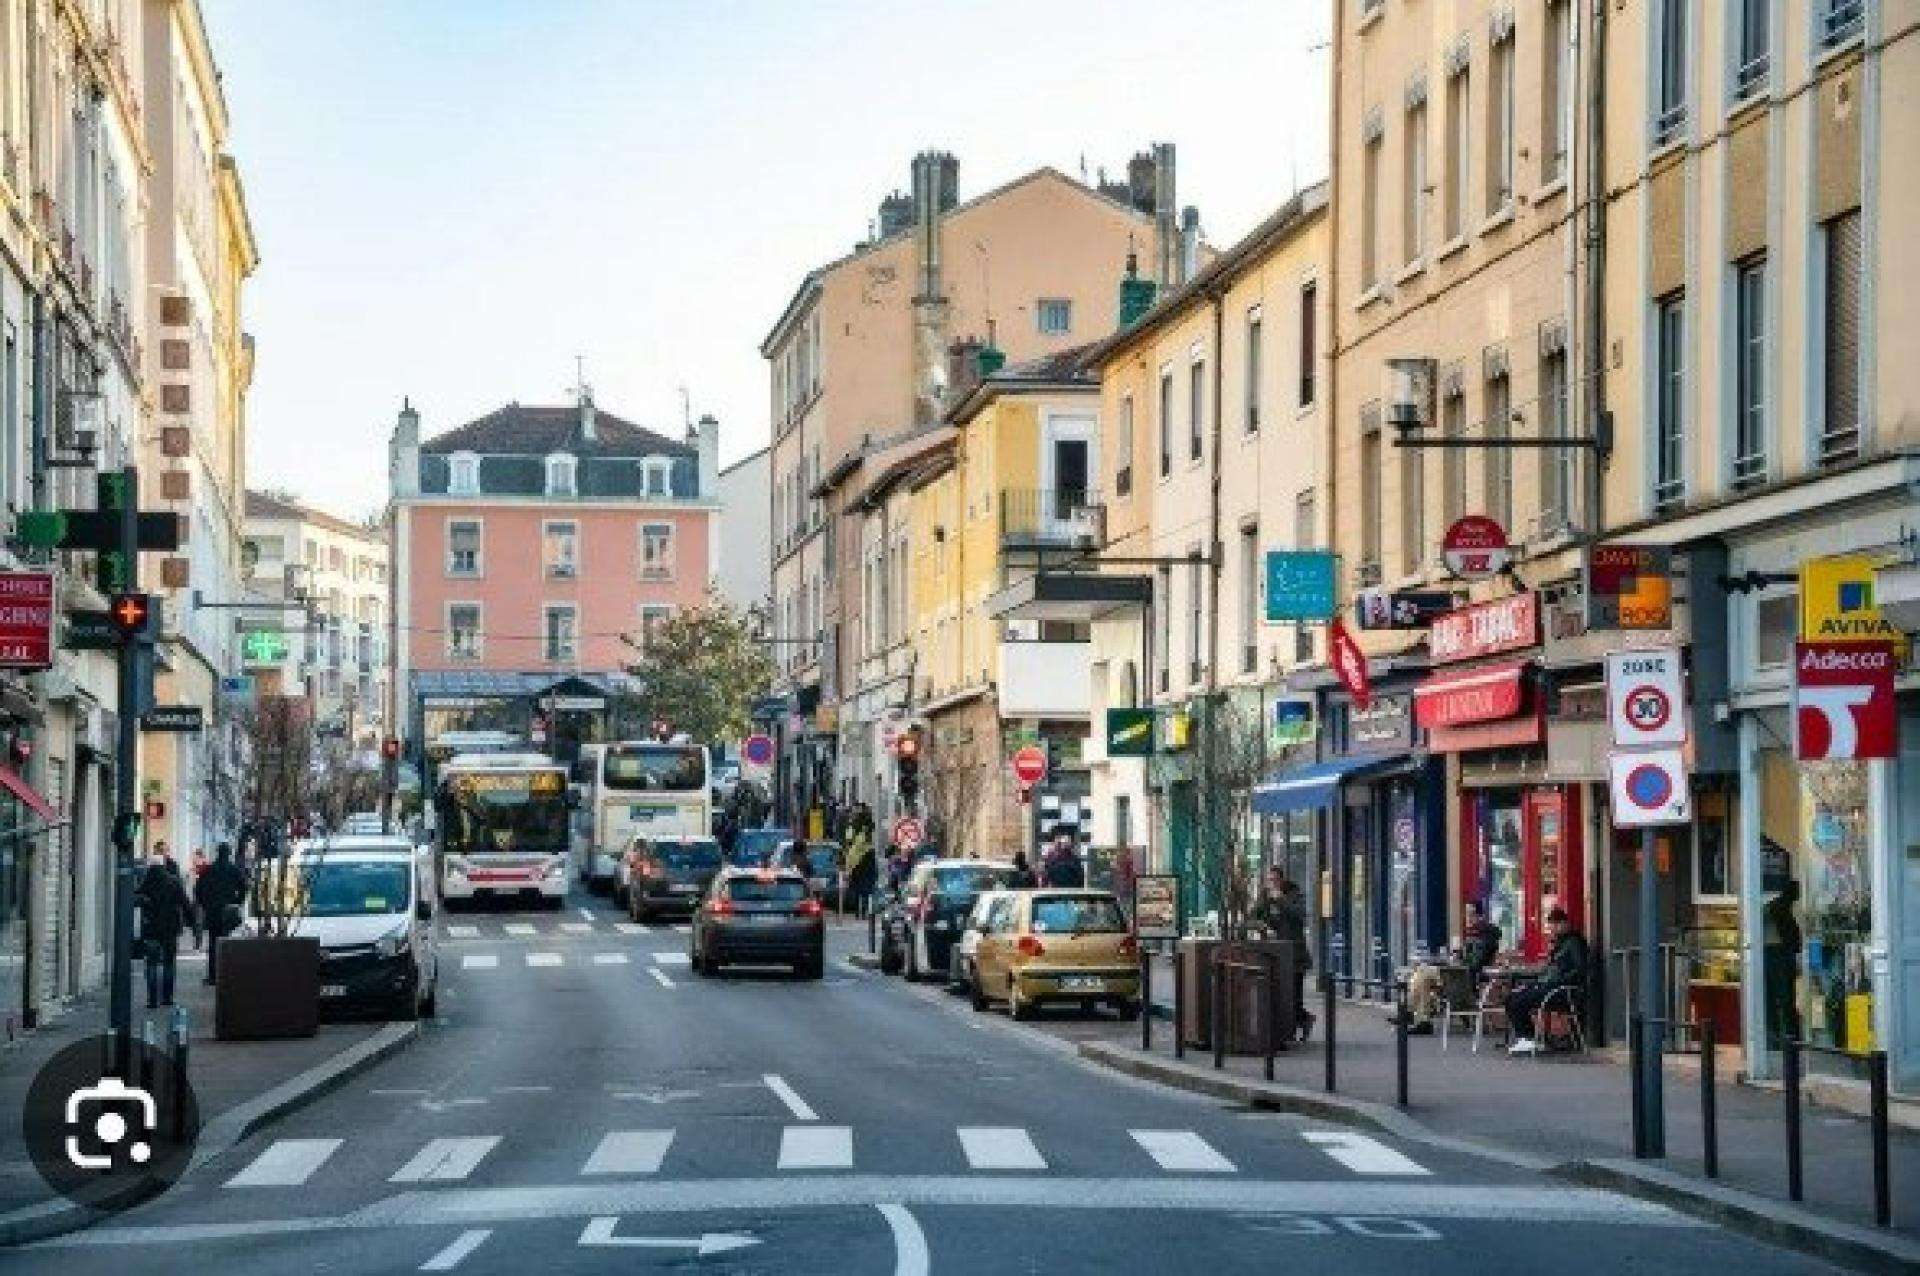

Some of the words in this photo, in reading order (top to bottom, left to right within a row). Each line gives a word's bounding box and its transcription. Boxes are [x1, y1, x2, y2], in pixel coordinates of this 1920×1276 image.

[1819, 618, 1895, 635] AVIVA
[1800, 649, 1889, 671] Adecco
[1634, 697, 1661, 719] 30
